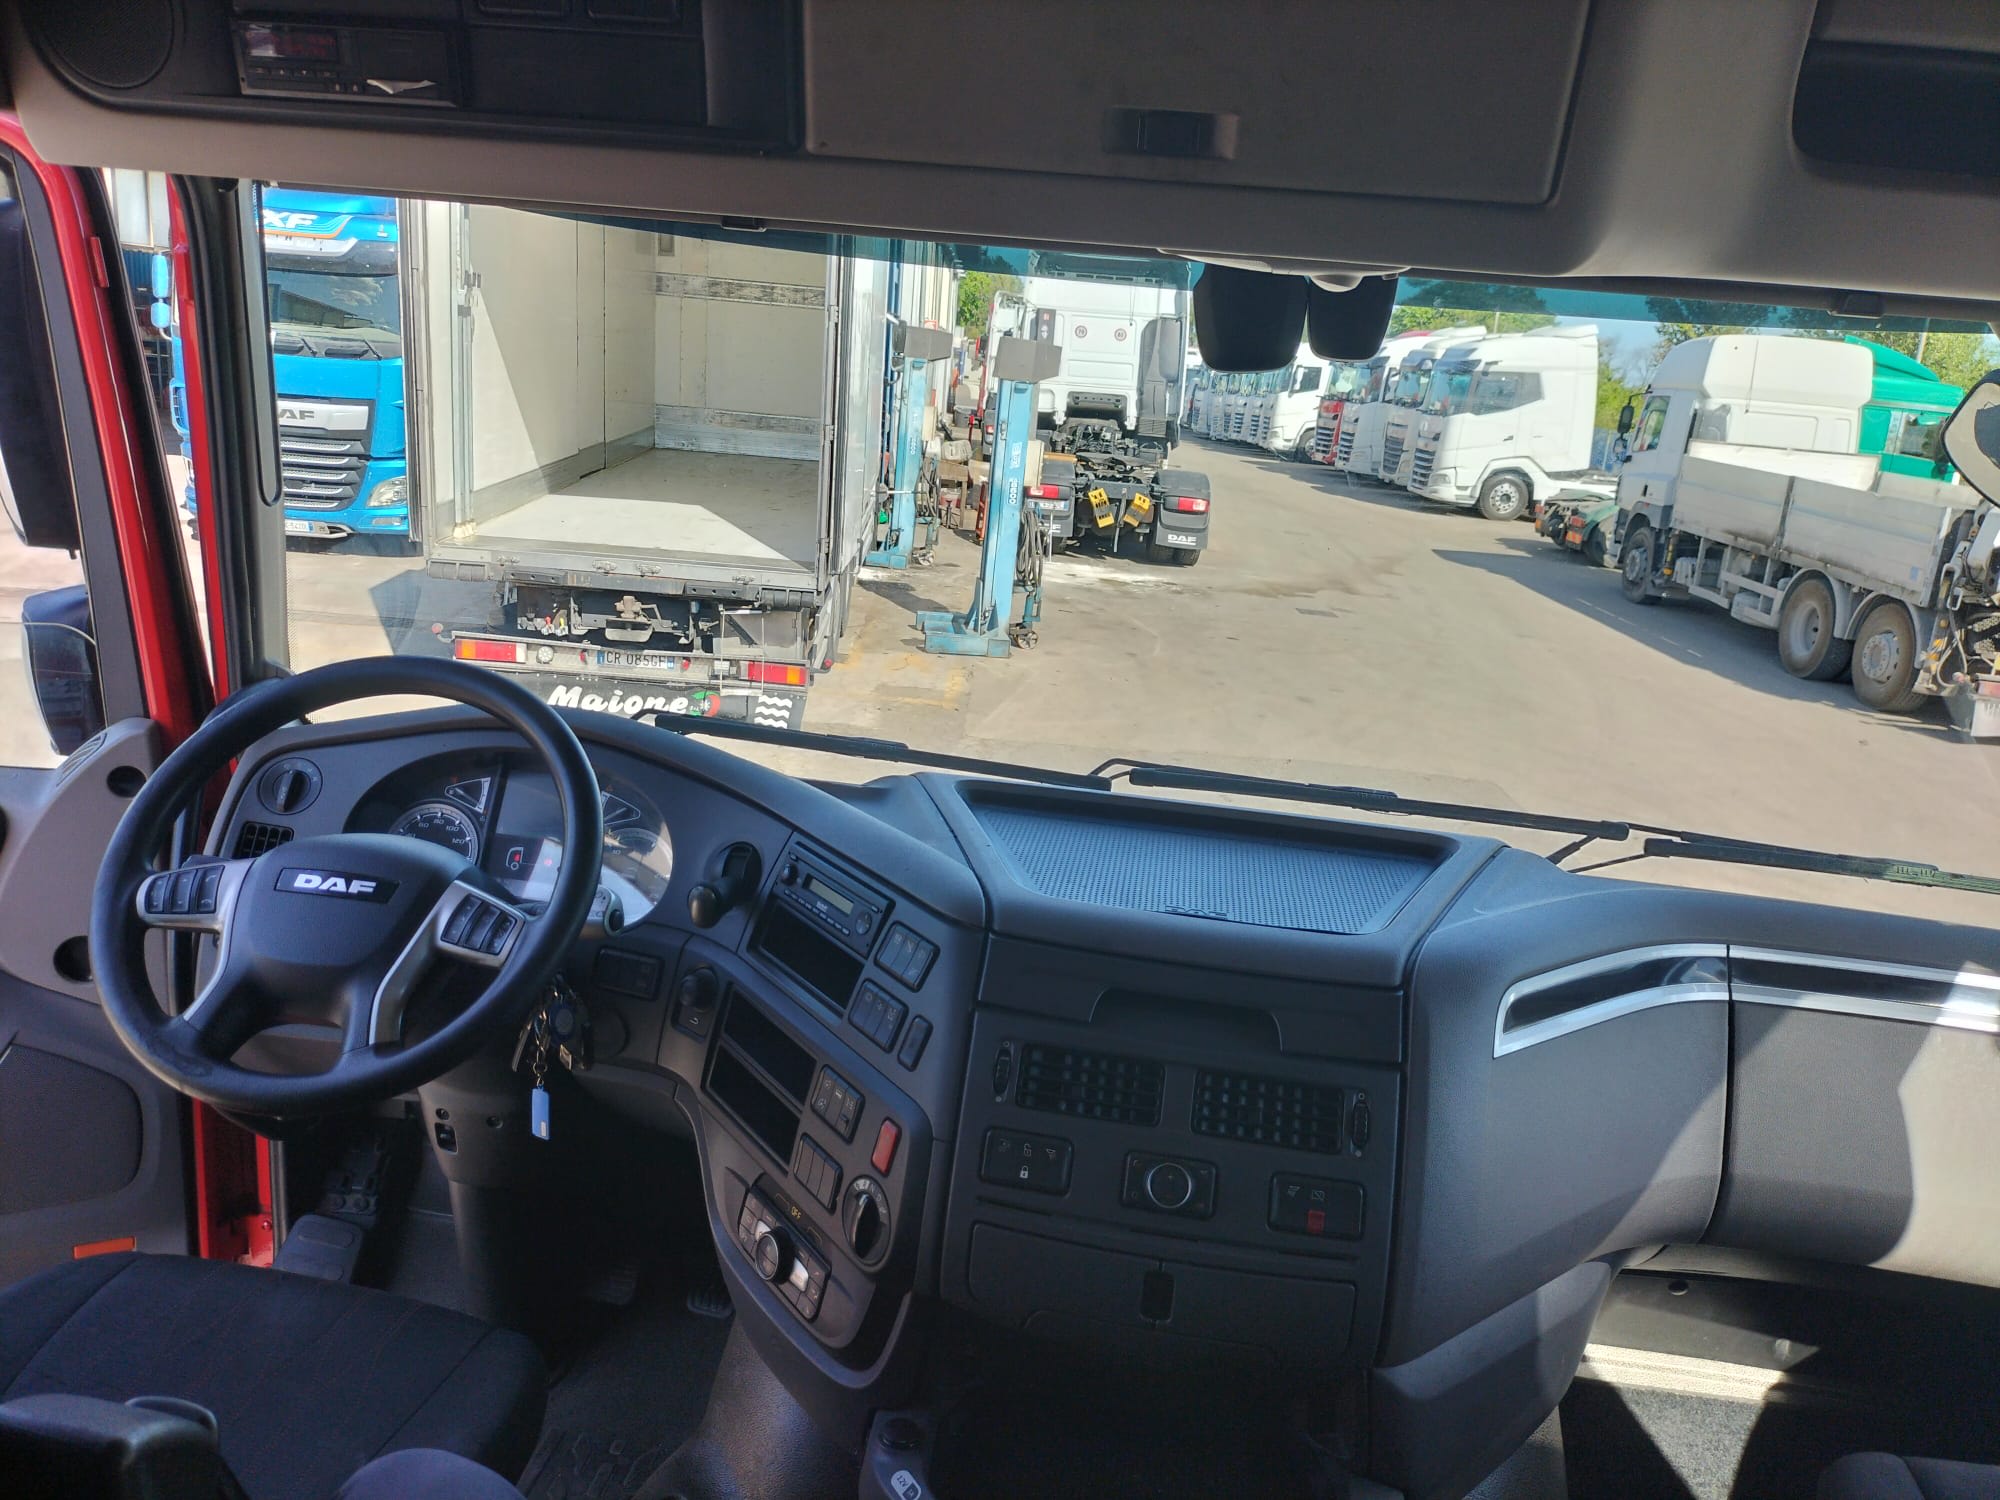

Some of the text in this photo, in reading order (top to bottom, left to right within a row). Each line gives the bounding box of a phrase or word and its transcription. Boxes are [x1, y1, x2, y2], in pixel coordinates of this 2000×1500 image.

[279, 408, 314, 420] AF
[1167, 534, 1197, 543] DAF
[606, 651, 621, 664] CR
[547, 685, 689, 715] Maione
[452, 837, 465, 845] 120
[293, 873, 377, 894] DAF
